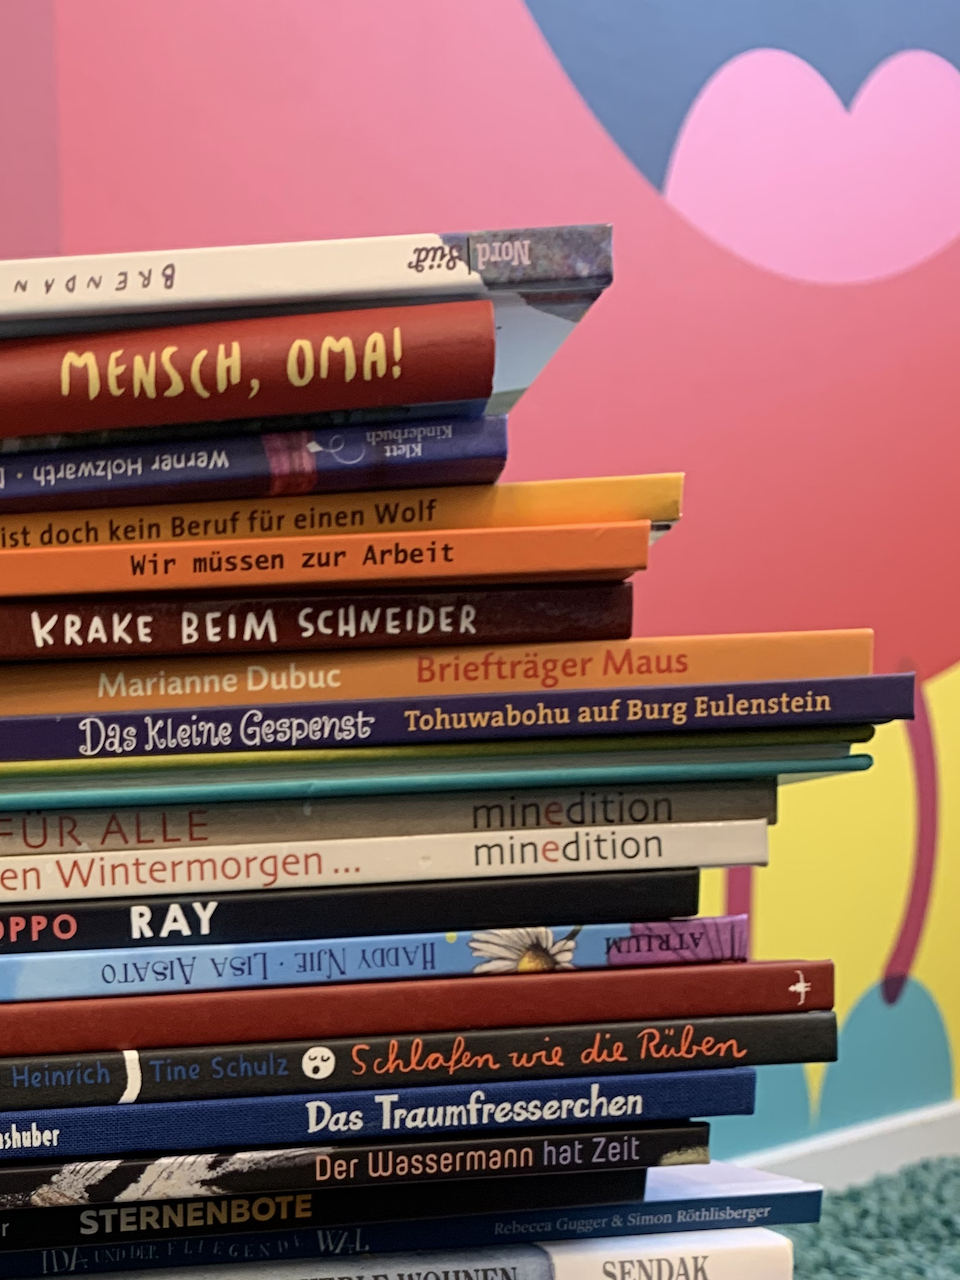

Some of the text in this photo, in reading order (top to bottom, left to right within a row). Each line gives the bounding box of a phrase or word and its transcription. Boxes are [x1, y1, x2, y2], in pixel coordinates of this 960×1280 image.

[60, 326, 403, 400] MENSCH, OMA!
[365, 425, 453, 443] Kinderbuch
[385, 444, 422, 458] Klett
[32, 458, 143, 486] Holzwarth
[151, 450, 230, 472] Werner
[131, 543, 454, 576] Wir müssen zur Arbeit
[31, 604, 477, 648] KRAKE BEIM SCHNEIDER
[98, 665, 341, 698] Marianne Dubuc
[417, 648, 688, 688] Briefträger Maus
[405, 692, 832, 732] Tohuwabohu auf Burg Eulenstein
[79, 709, 375, 756] Das Kleine Gespenst
[475, 831, 662, 866] minedition
[130, 901, 217, 939] RAY
[604, 929, 705, 954] ATRIUM
[12, 1062, 111, 1088] Heinrich
[149, 1060, 200, 1082] Tine
[211, 1052, 289, 1078] Schulz
[306, 1083, 643, 1134] Das Traumfresserchen
[79, 1193, 313, 1235] STERNENBOTE
[494, 1203, 771, 1236] Rebecca Gugger & Simon Röthlisberger
